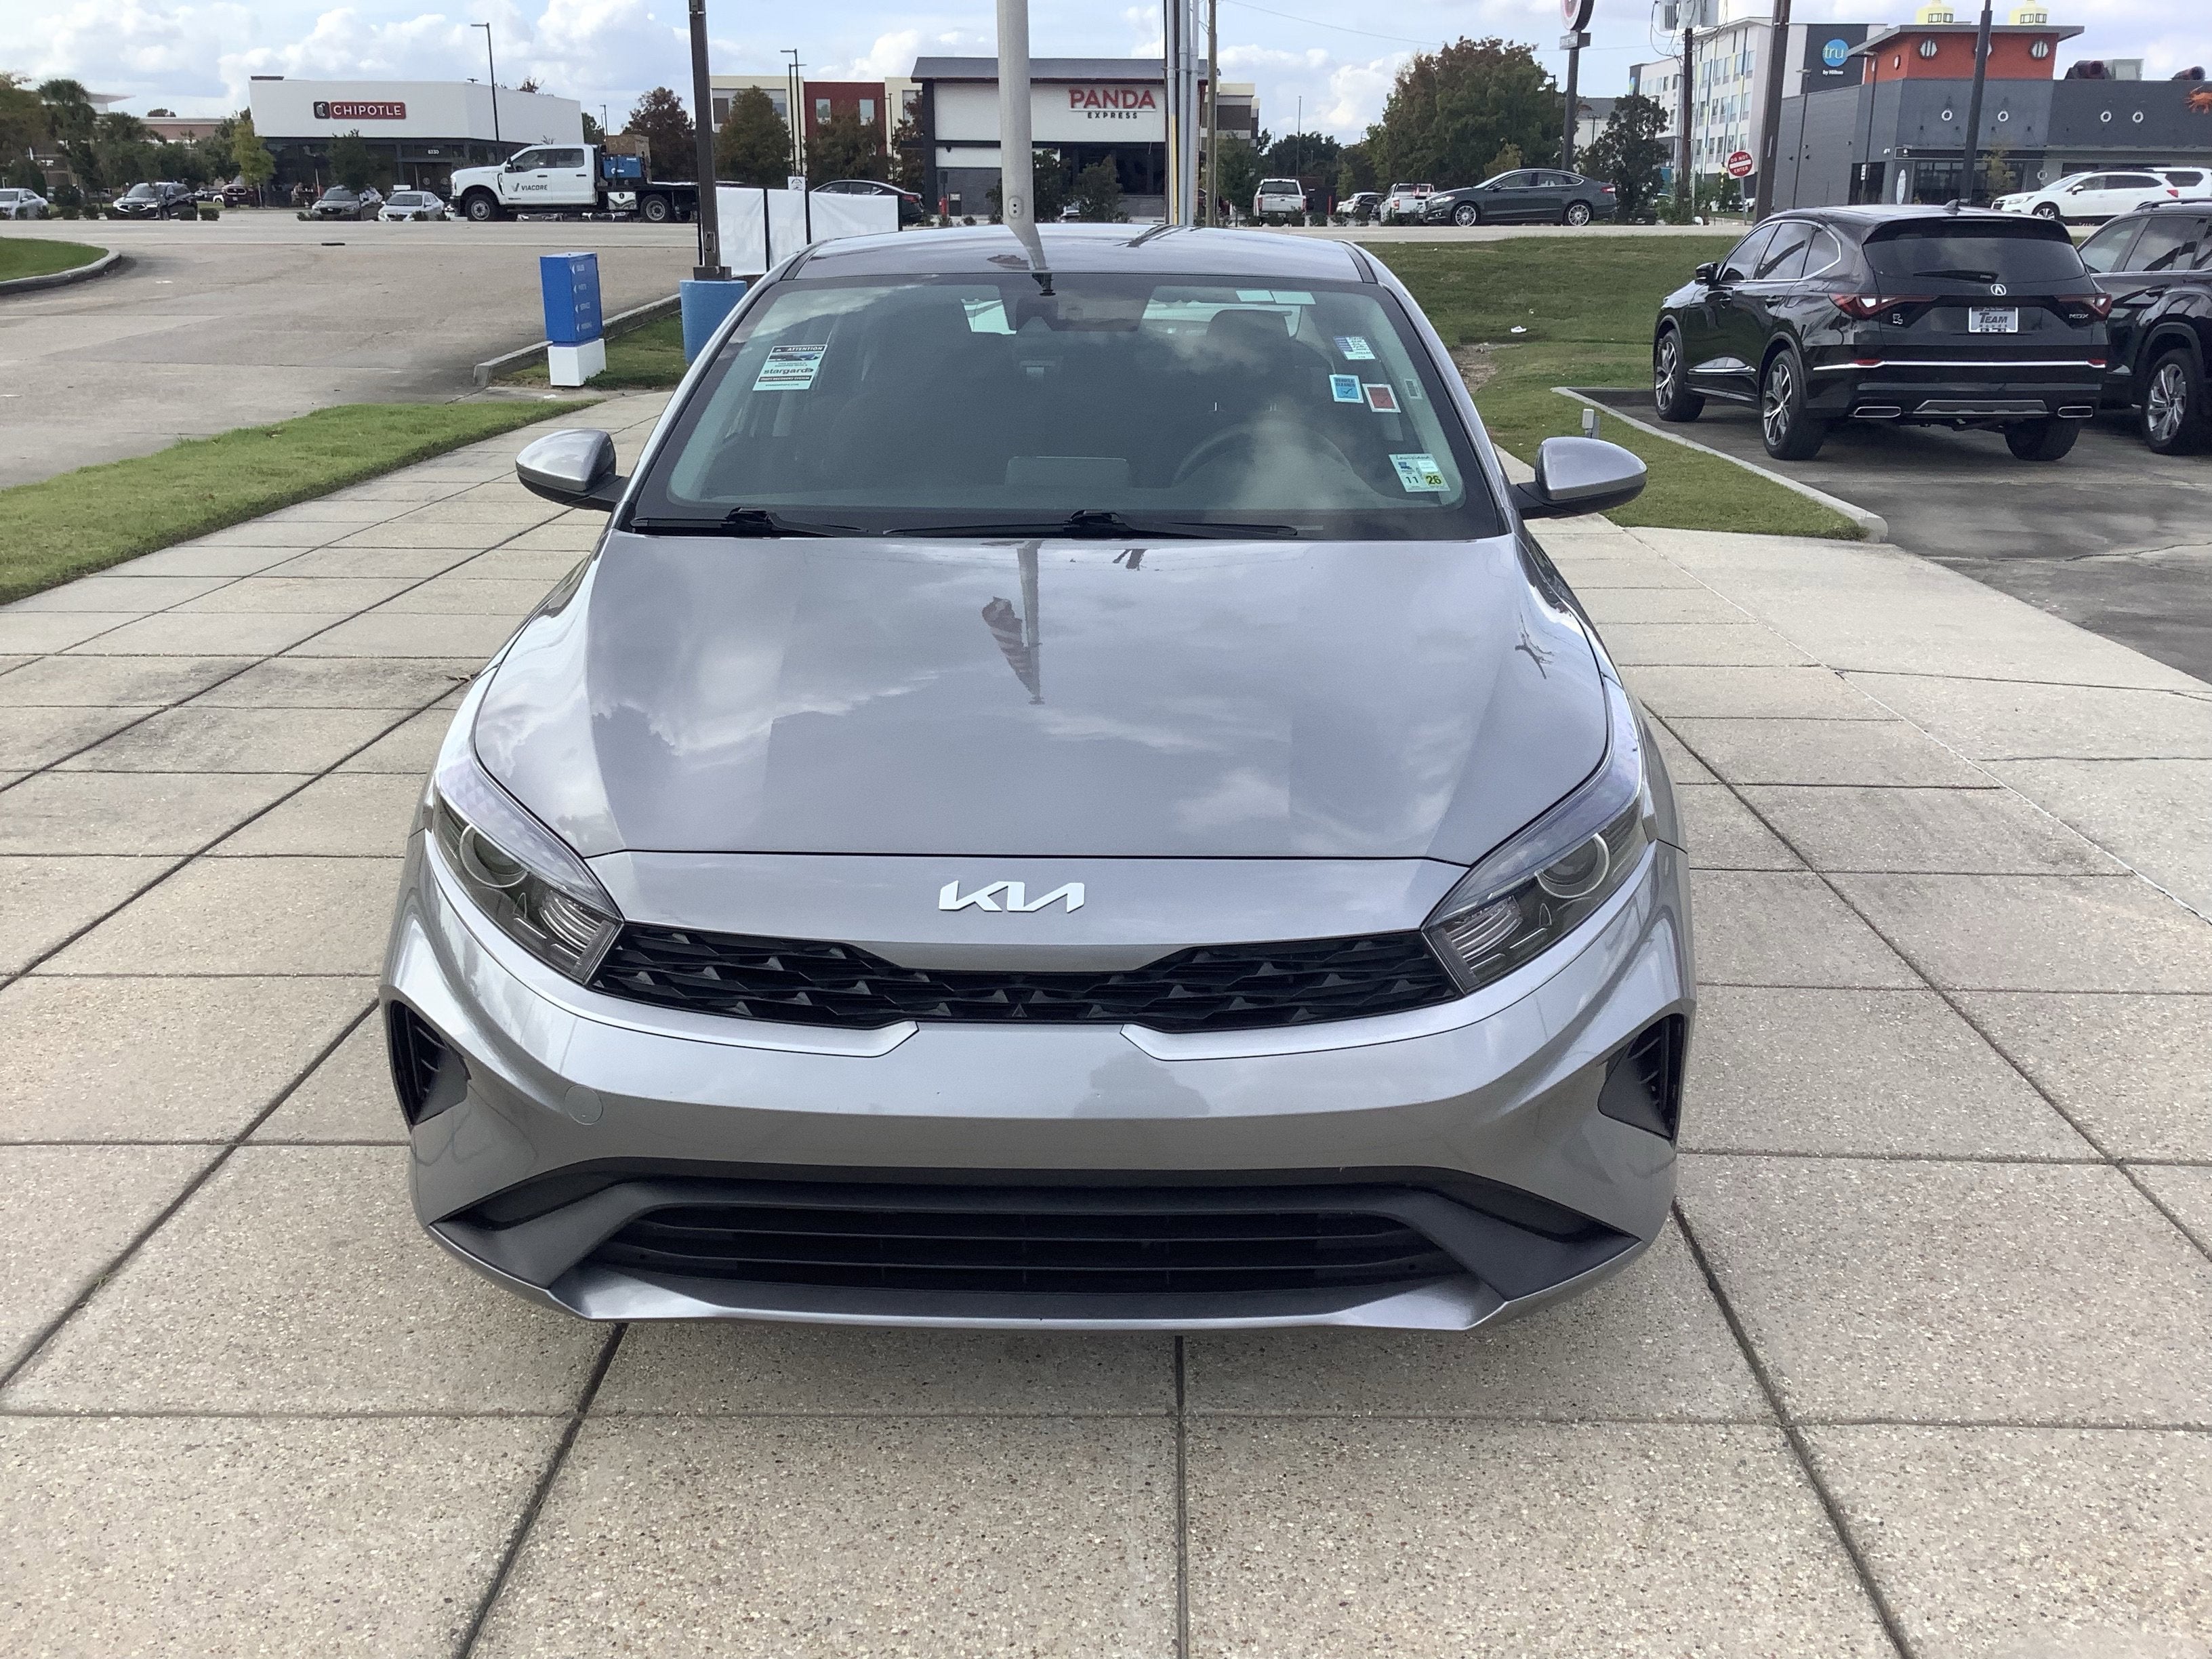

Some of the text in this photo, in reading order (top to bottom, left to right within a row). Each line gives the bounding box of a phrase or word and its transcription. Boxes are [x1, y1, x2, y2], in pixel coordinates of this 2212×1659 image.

[1823, 45, 1844, 59] tru
[1069, 89, 1155, 108] PANDA
[333, 105, 401, 115] CHIPOTLE
[1426, 475, 1441, 485] 26
